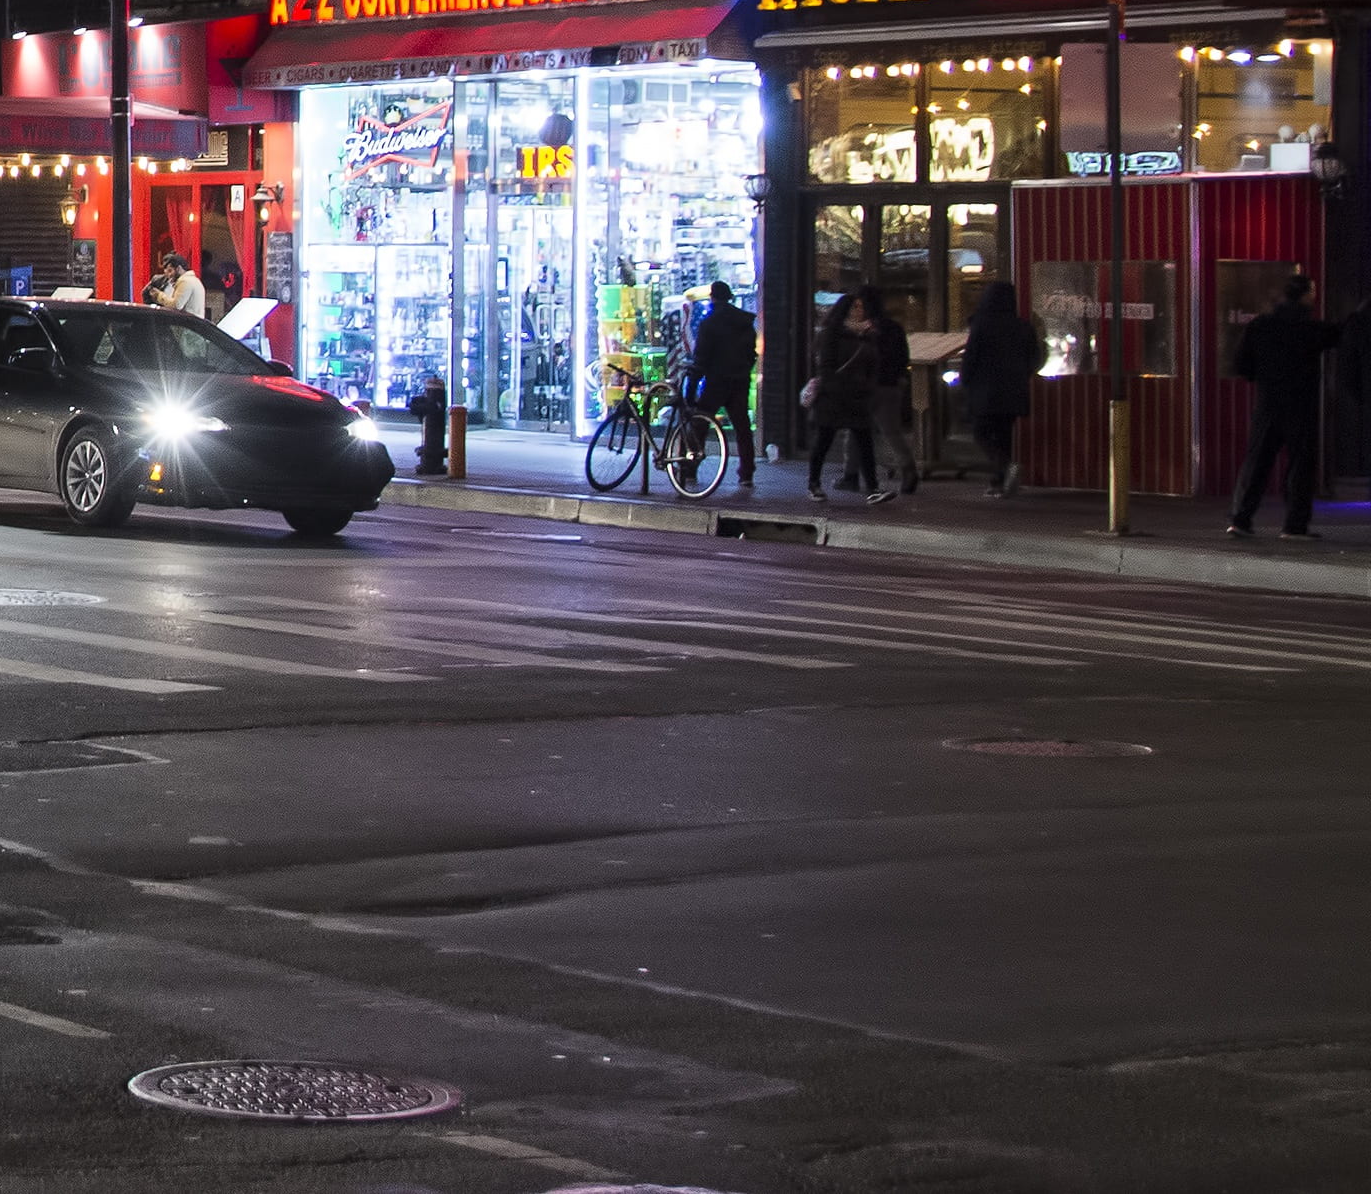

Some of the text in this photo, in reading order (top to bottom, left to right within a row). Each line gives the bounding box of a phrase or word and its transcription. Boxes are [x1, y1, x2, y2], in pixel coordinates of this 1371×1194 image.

[286, 66, 325, 82] CIGARS
[338, 59, 407, 80] CIGARETTES
[419, 58, 458, 76] CANDY
[669, 41, 700, 58] TAXI
[344, 127, 450, 163] Budweiser
